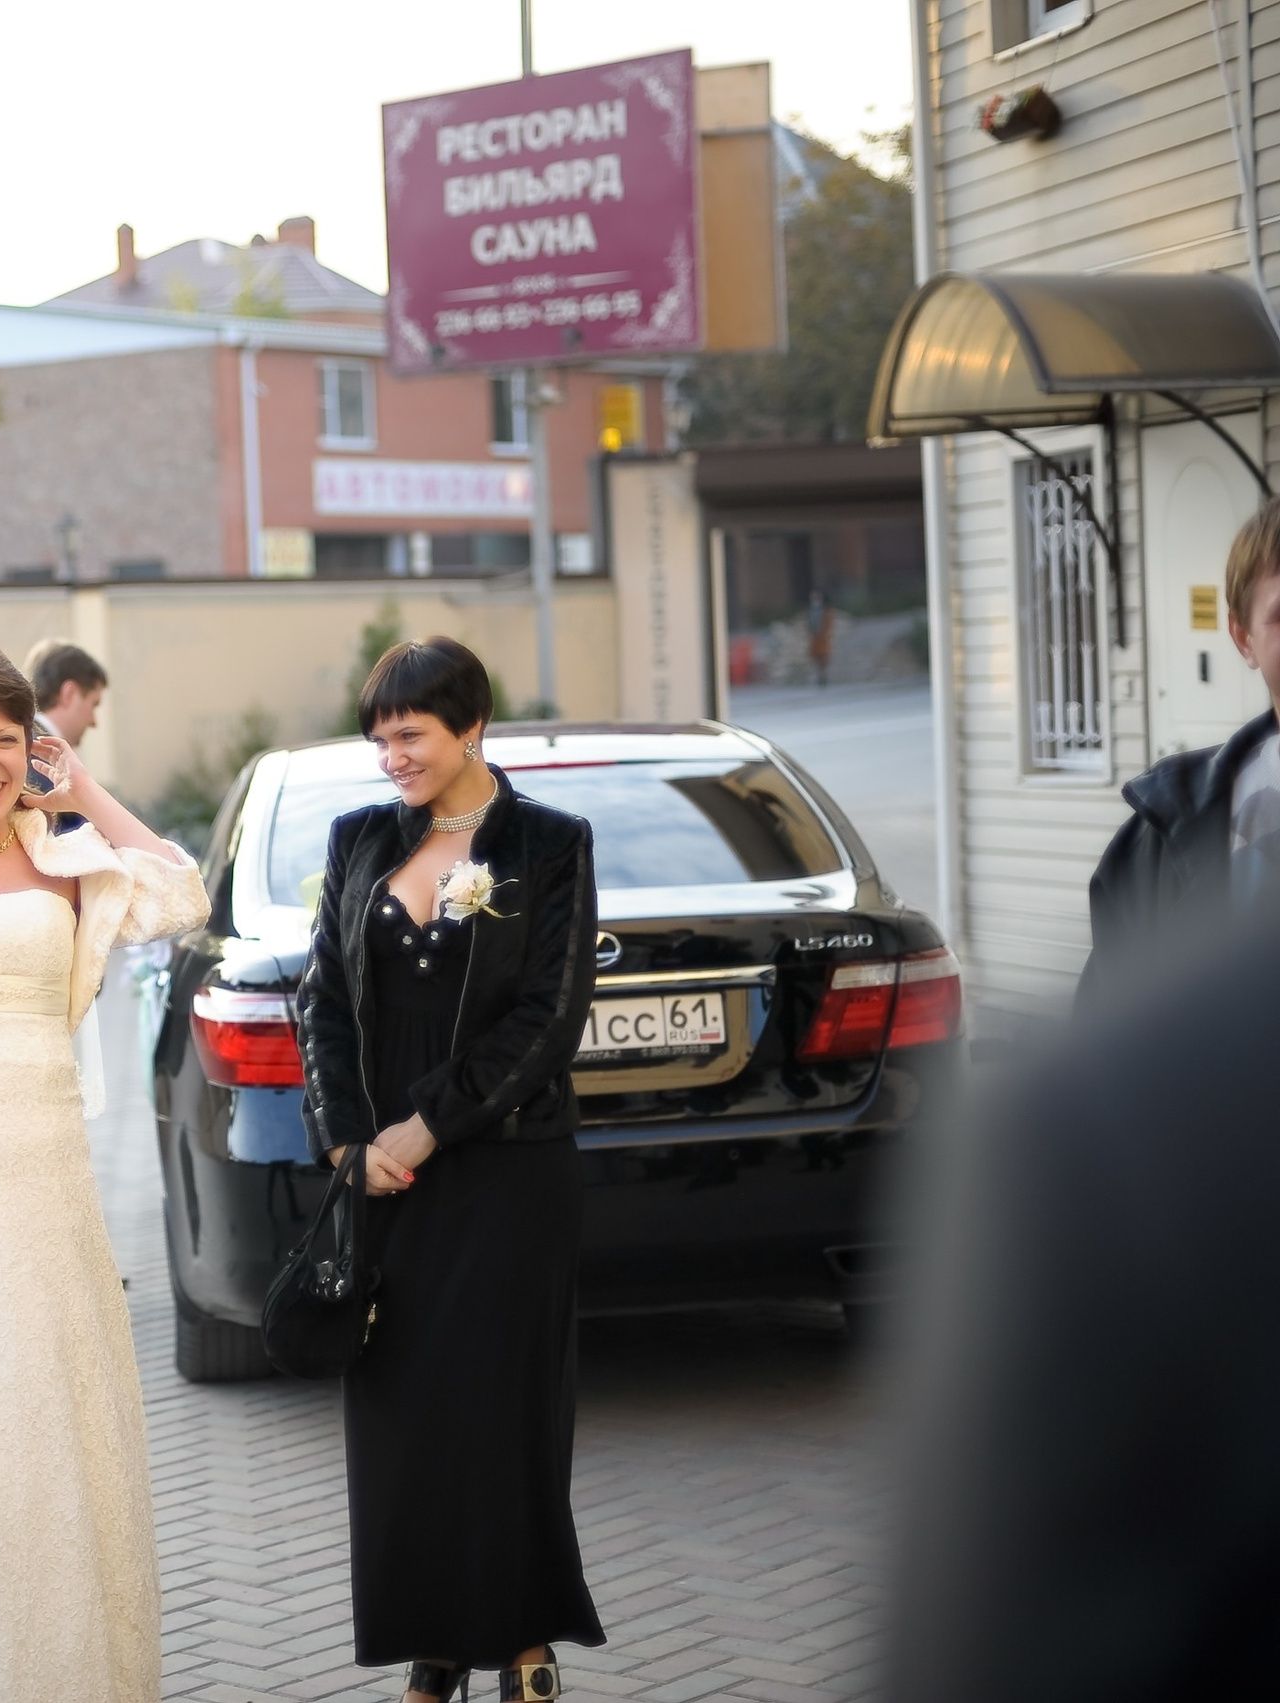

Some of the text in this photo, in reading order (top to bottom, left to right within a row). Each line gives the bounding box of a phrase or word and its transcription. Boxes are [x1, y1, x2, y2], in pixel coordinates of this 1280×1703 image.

[436, 98, 628, 167] РЕСТОРАН
[443, 153, 625, 218] БИЛЬЯРД
[471, 212, 598, 266] САУНА
[670, 998, 707, 1029] 61
[670, 1029, 699, 1041] RUS
